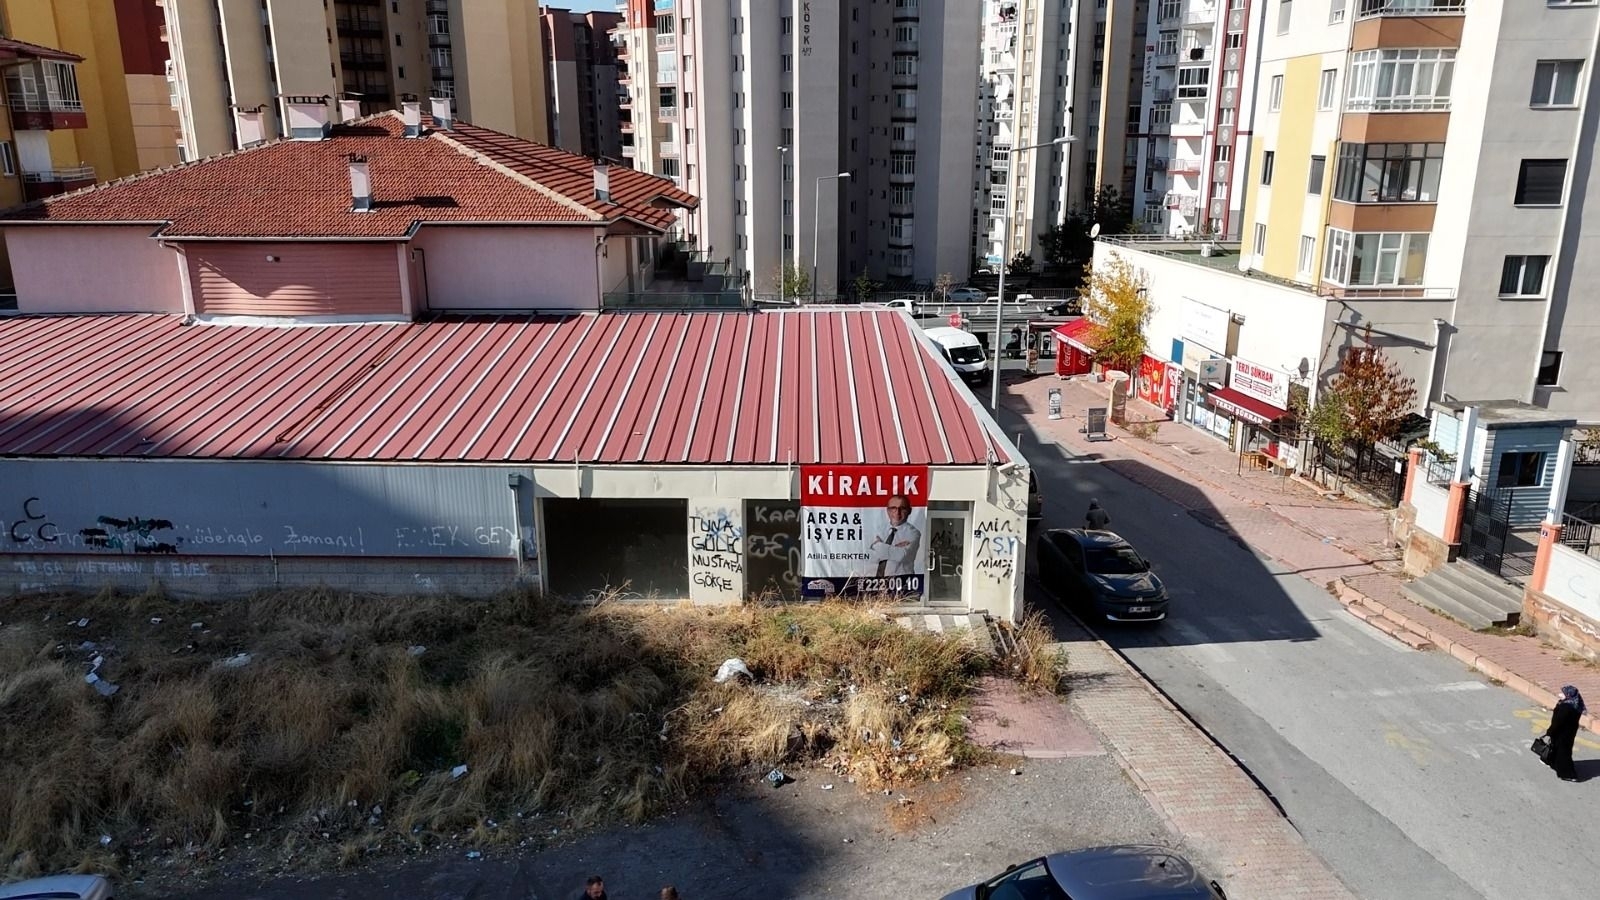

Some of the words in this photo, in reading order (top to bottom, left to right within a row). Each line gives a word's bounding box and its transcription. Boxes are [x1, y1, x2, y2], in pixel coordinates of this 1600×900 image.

[808, 470, 919, 496] KİRALIK
[807, 525, 862, 543] İŞYERİ
[692, 554, 742, 574] MUSTAFA
[866, 579, 886, 591] 222
[888, 577, 902, 590] 00
[905, 577, 919, 590] 10
